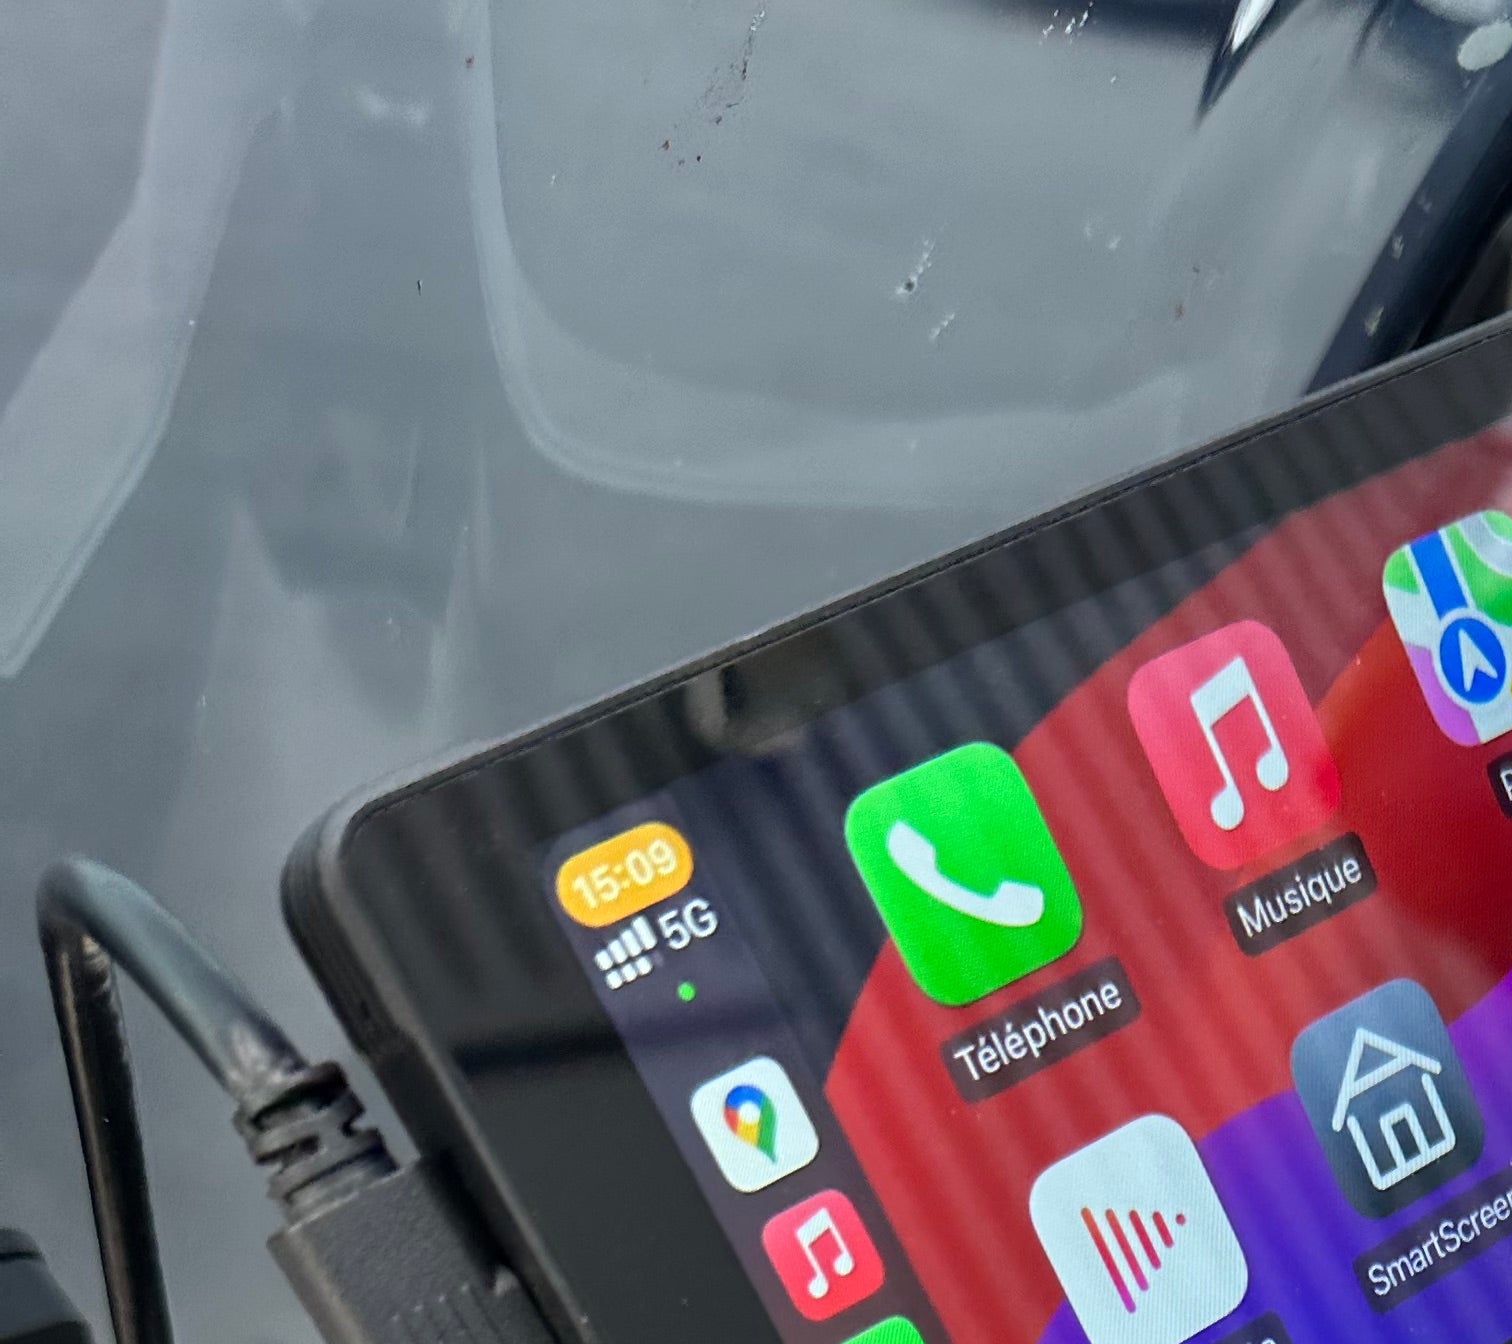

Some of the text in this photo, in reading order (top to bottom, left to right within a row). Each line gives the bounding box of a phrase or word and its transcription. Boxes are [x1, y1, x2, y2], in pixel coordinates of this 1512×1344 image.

[571, 839, 678, 909] 15:09
[1236, 854, 1363, 939] Musique
[656, 897, 718, 951] 5G
[953, 976, 1123, 1084] Téléphone
